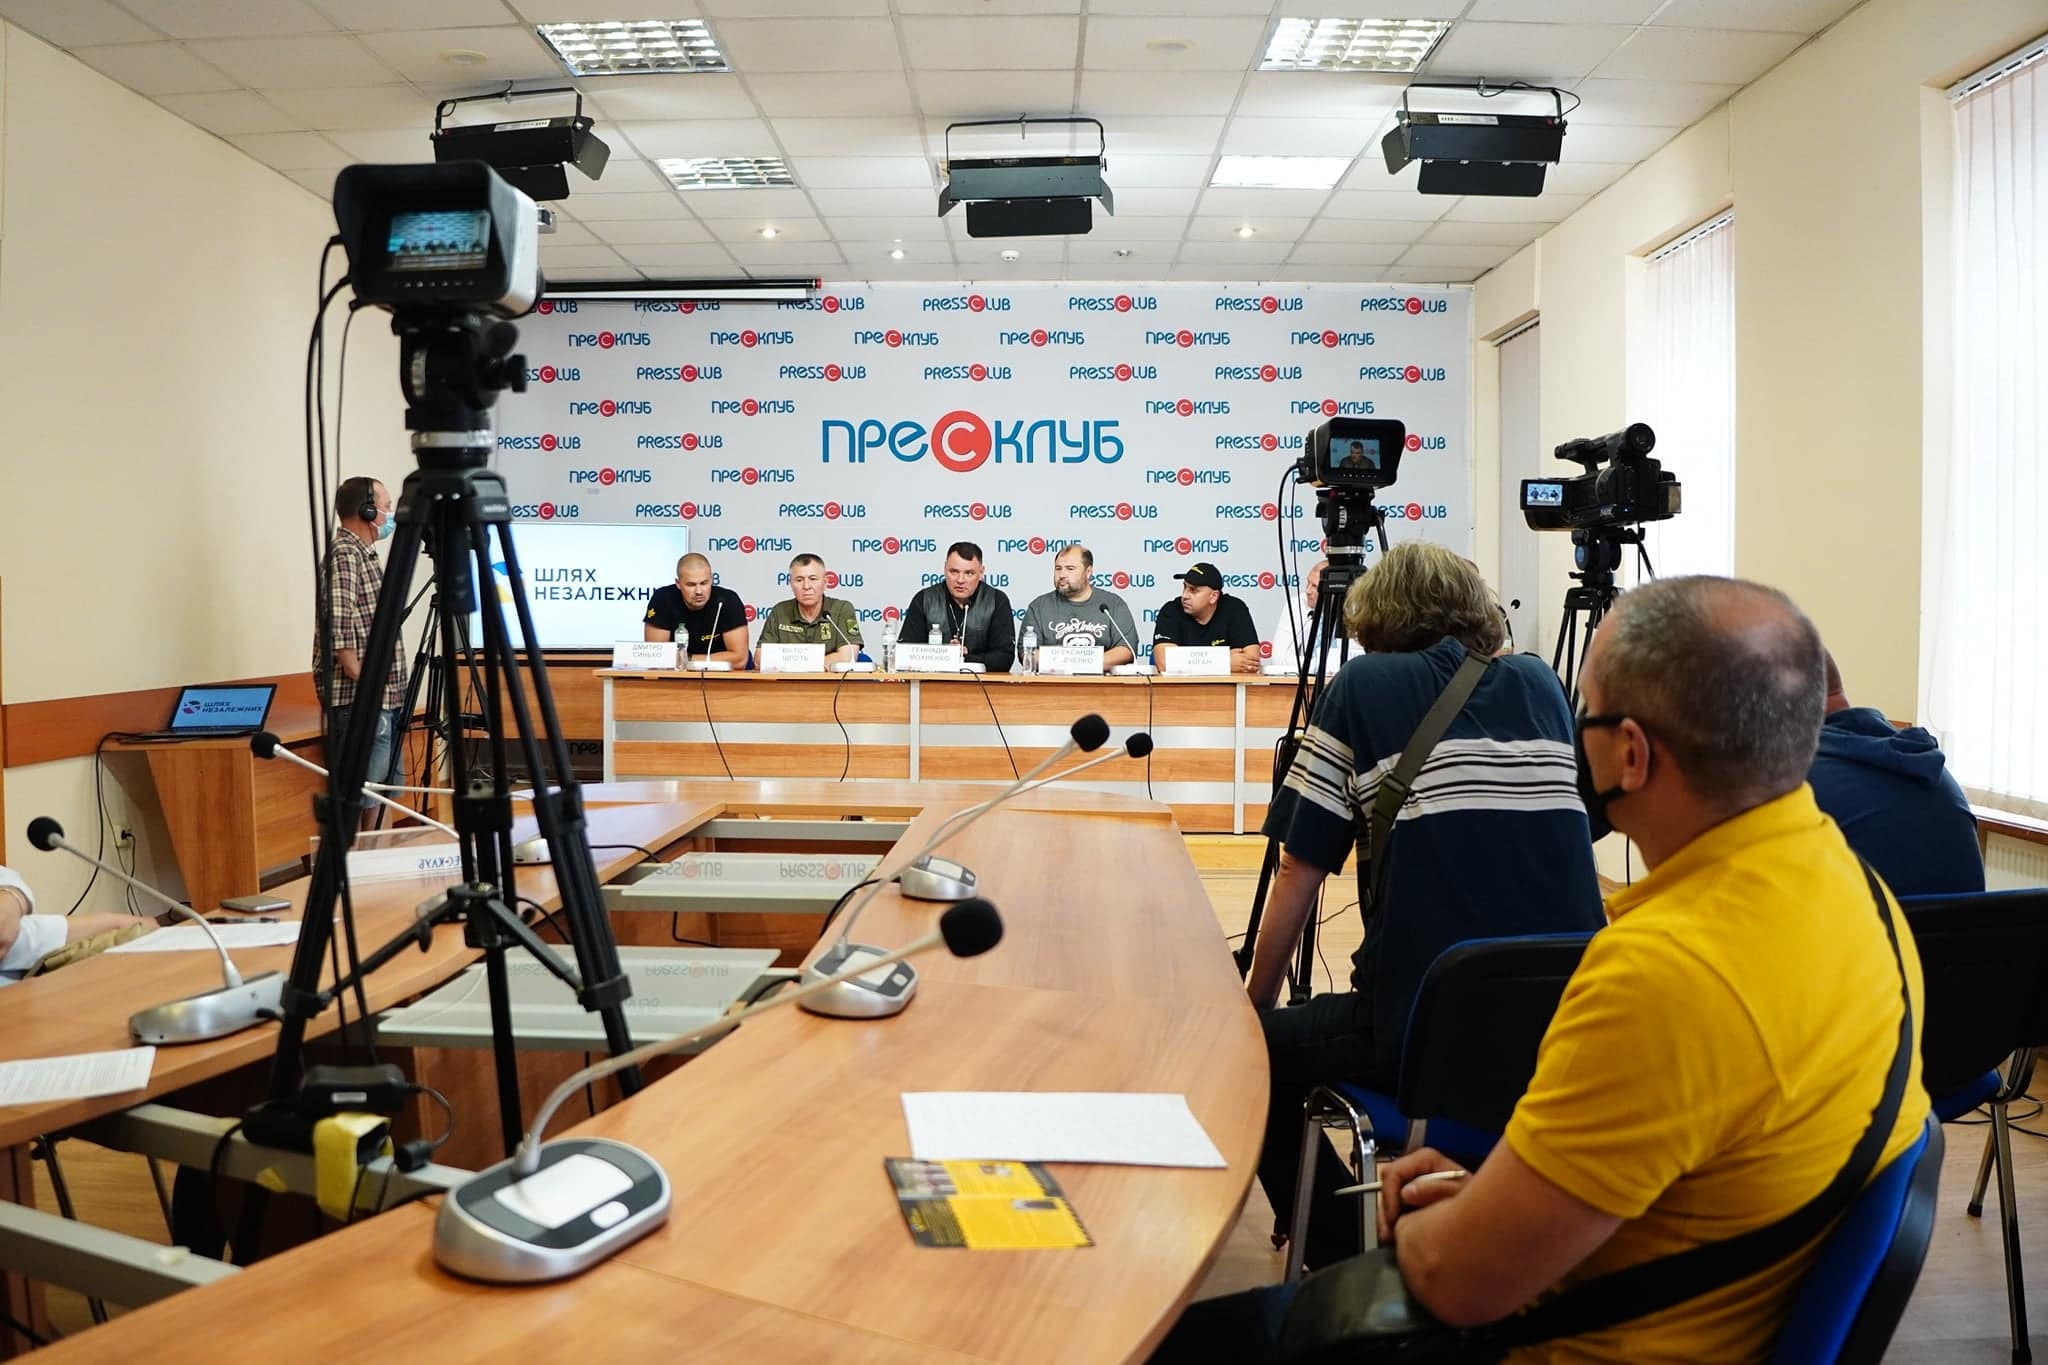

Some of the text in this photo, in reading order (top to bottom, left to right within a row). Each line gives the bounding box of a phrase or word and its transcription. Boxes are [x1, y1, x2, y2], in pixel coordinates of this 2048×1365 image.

[525, 365, 581, 384] SSCLUB
[509, 502, 579, 520] ESSCLUB
[535, 568, 597, 582] ШЛЯХ
[1221, 571, 1300, 590] RESSCLUB
[535, 587, 657, 601] НЕЗАЛЕЖН
